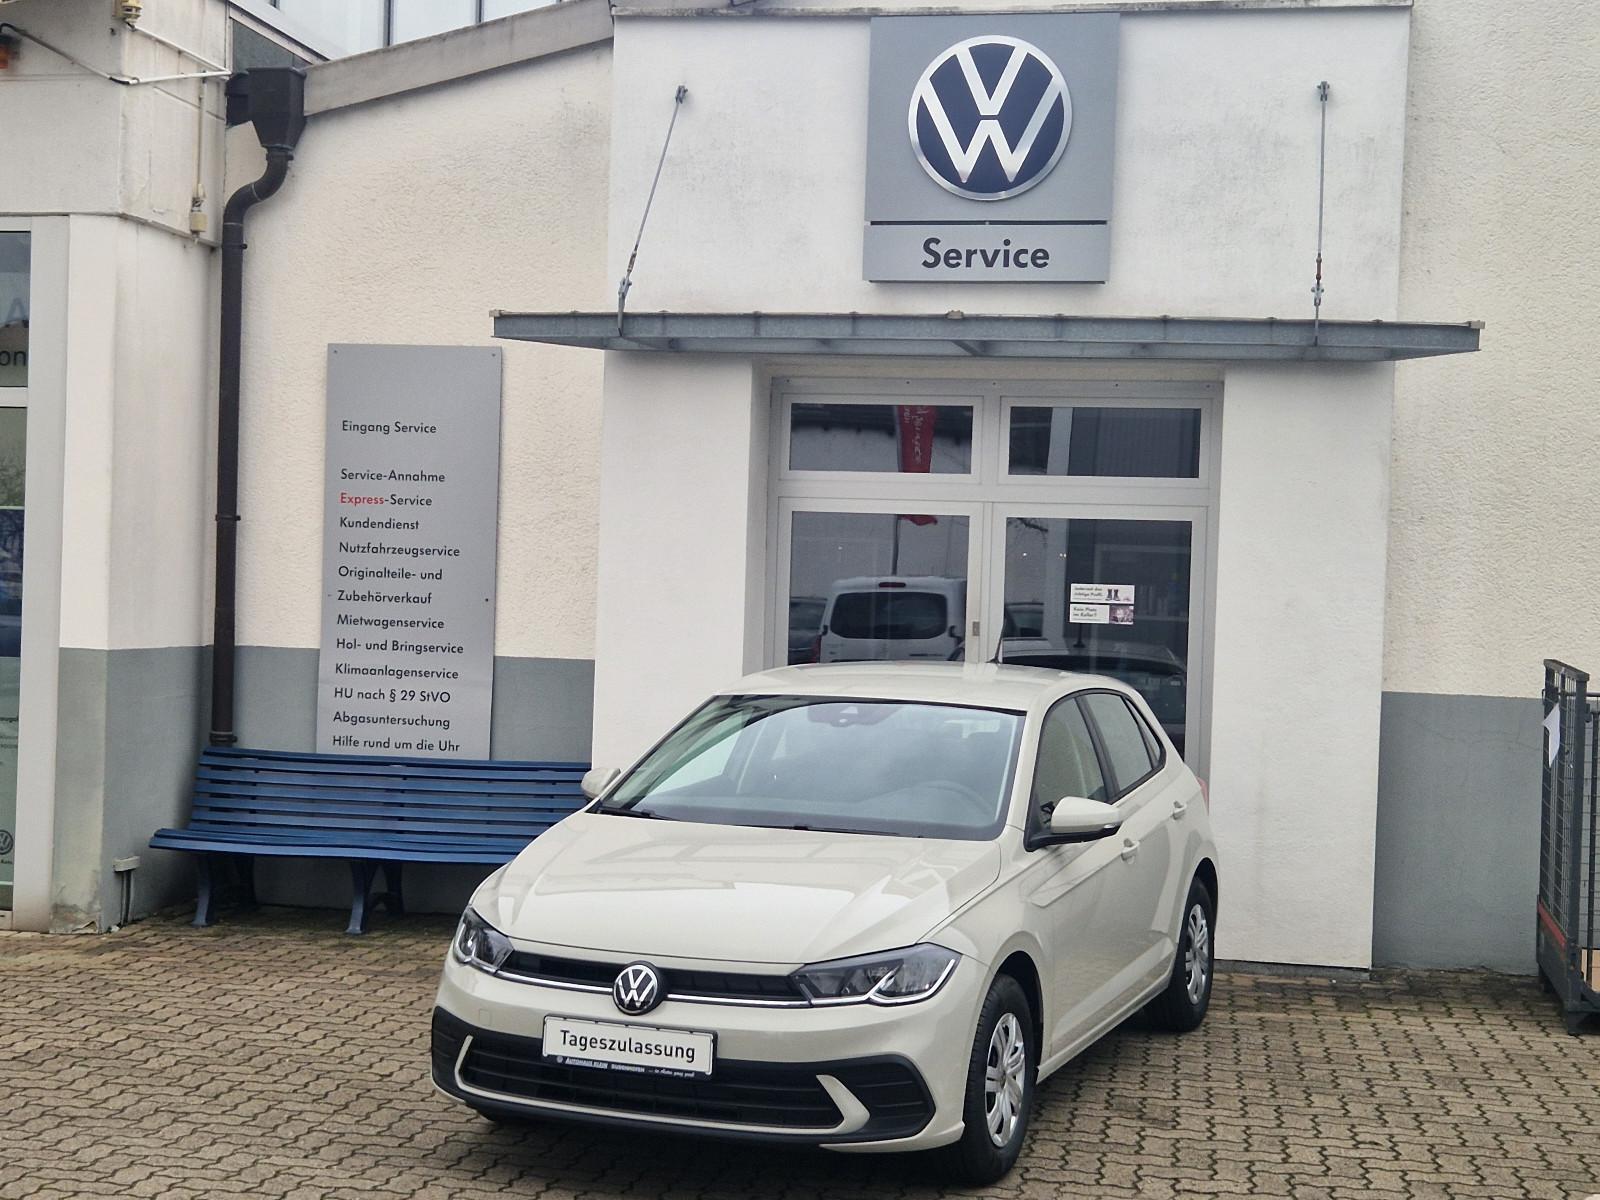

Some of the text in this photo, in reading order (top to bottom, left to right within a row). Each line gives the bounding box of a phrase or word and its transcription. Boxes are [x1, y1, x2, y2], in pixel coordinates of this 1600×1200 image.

[922, 237, 1050, 269] Service
[342, 420, 436, 434] Eingang Service
[340, 469, 445, 482] Service-Annahme
[340, 493, 432, 506] Express-Service
[339, 517, 419, 529] Kundendienst
[339, 542, 460, 557] Nutzfahrzeugservice
[338, 566, 442, 580] Originalteile- und
[337, 590, 432, 604] Zubehörverkauf
[336, 614, 444, 629] Mietwagenservice
[336, 638, 463, 654] Hol- und Bringservice
[335, 663, 458, 679] Klimaanlagenservice
[333, 688, 450, 702] HU nach § 29 StVO
[332, 711, 450, 730] Abgasuntersuchung
[332, 736, 359, 747] Hilfe
[363, 737, 390, 748] rund
[416, 739, 434, 750] die
[438, 740, 460, 751] Uhr
[560, 1029, 695, 1062] Tageszulassung
